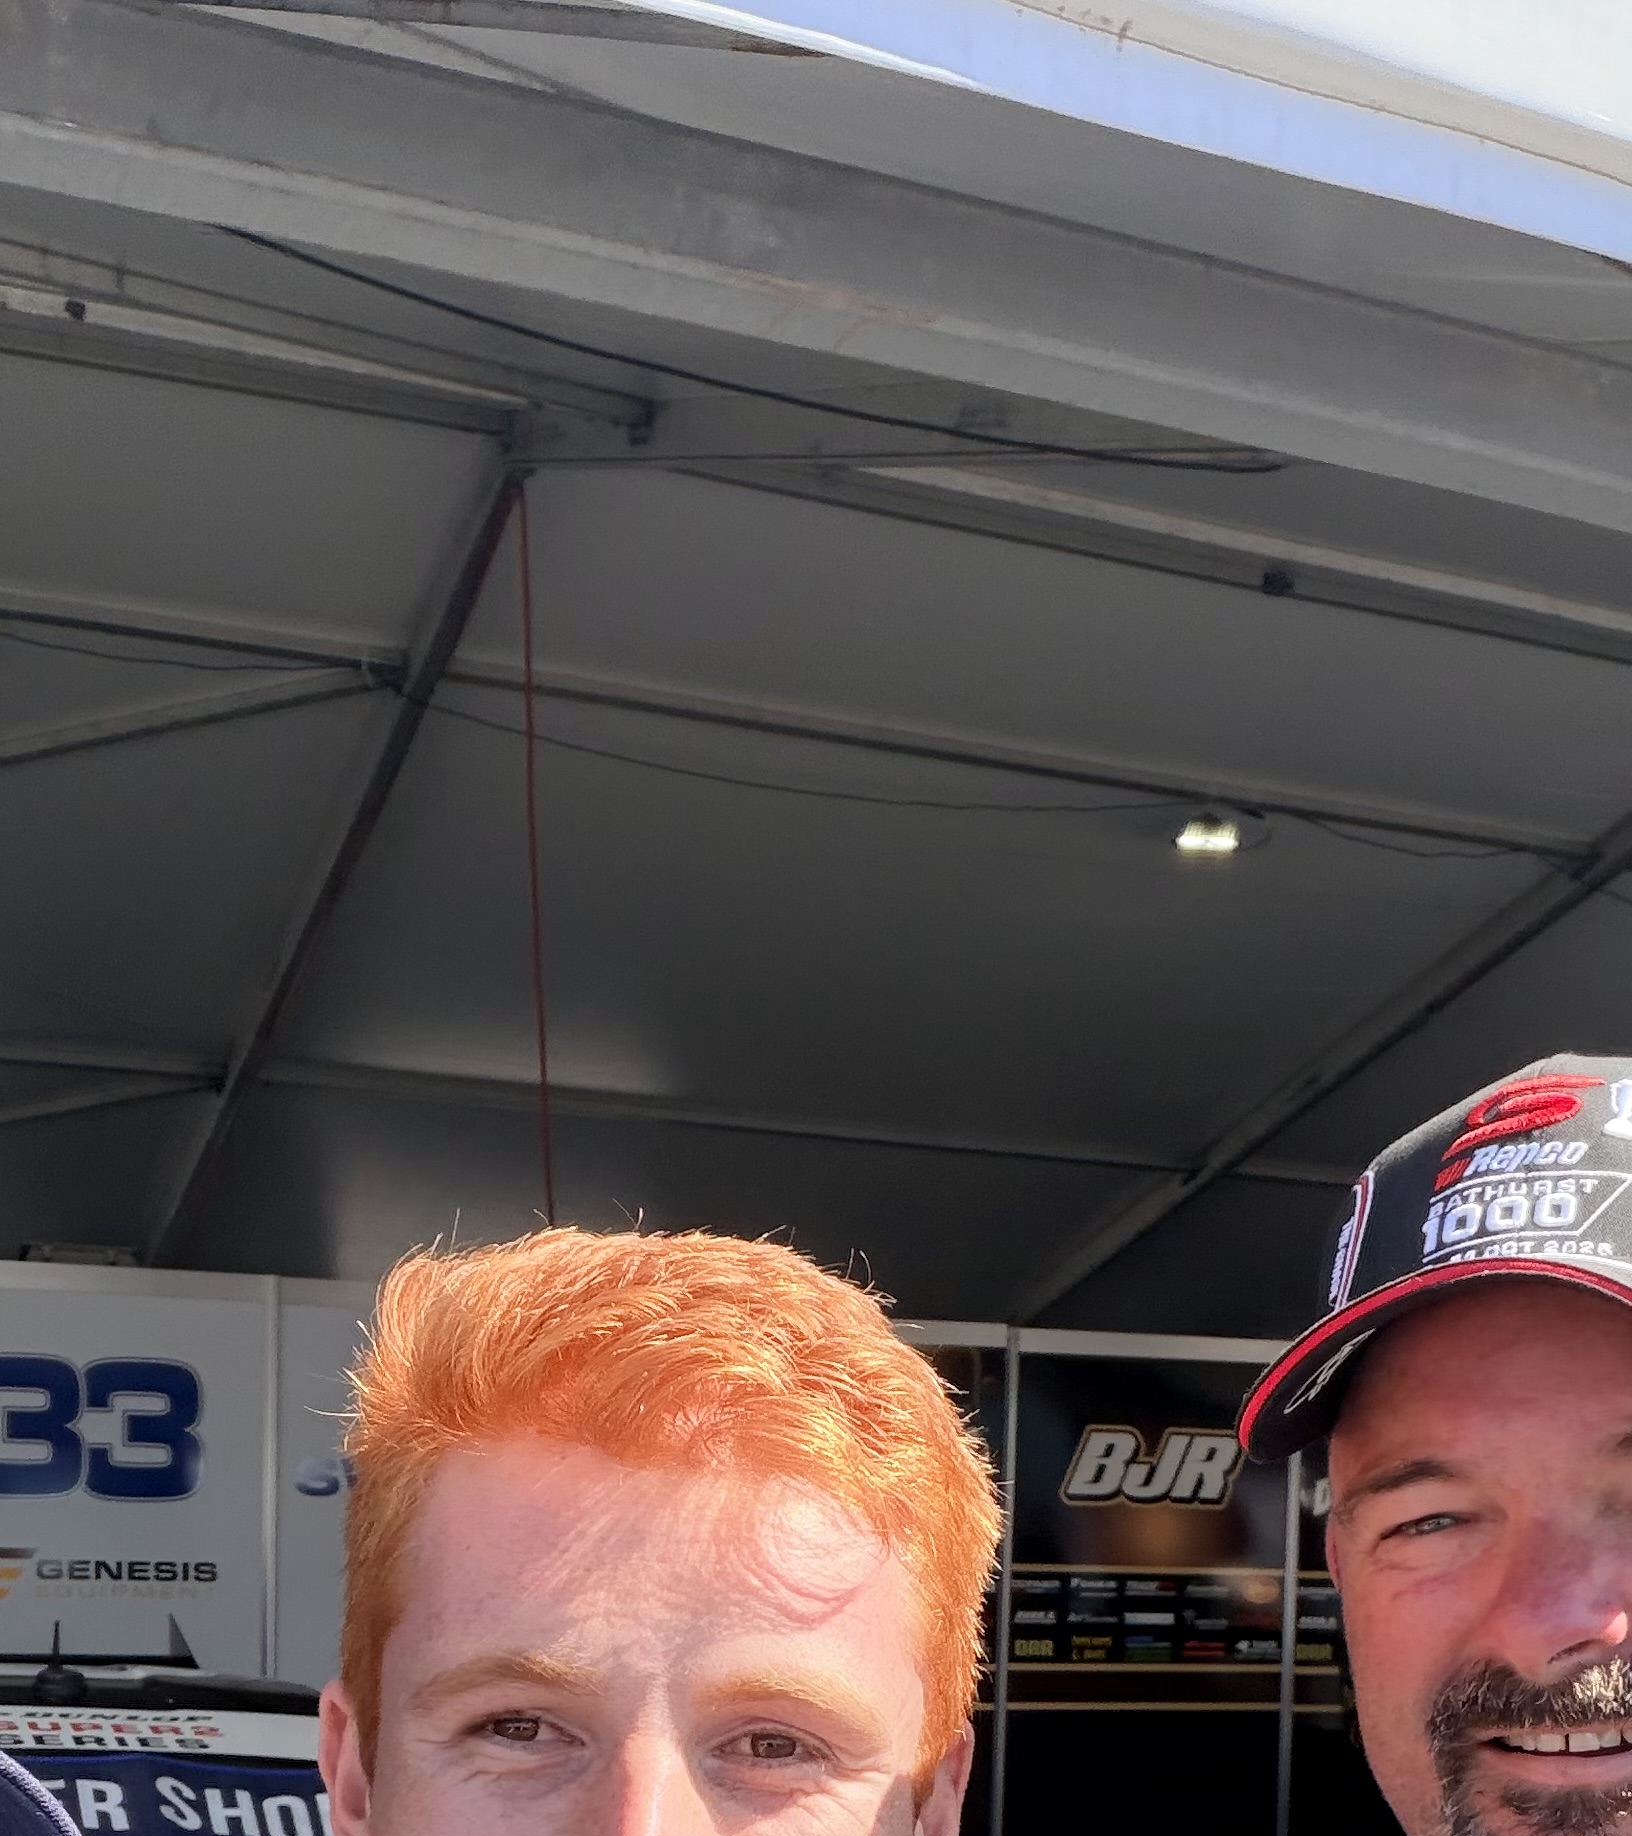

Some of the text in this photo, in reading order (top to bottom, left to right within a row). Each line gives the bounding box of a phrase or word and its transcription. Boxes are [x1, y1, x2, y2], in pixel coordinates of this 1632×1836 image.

[1421, 1192, 1577, 1257] 1000
[1428, 1178, 1599, 1219] BATHURST
[1060, 1426, 1243, 1509] BJR
[35, 1559, 219, 1584] GENESIS
